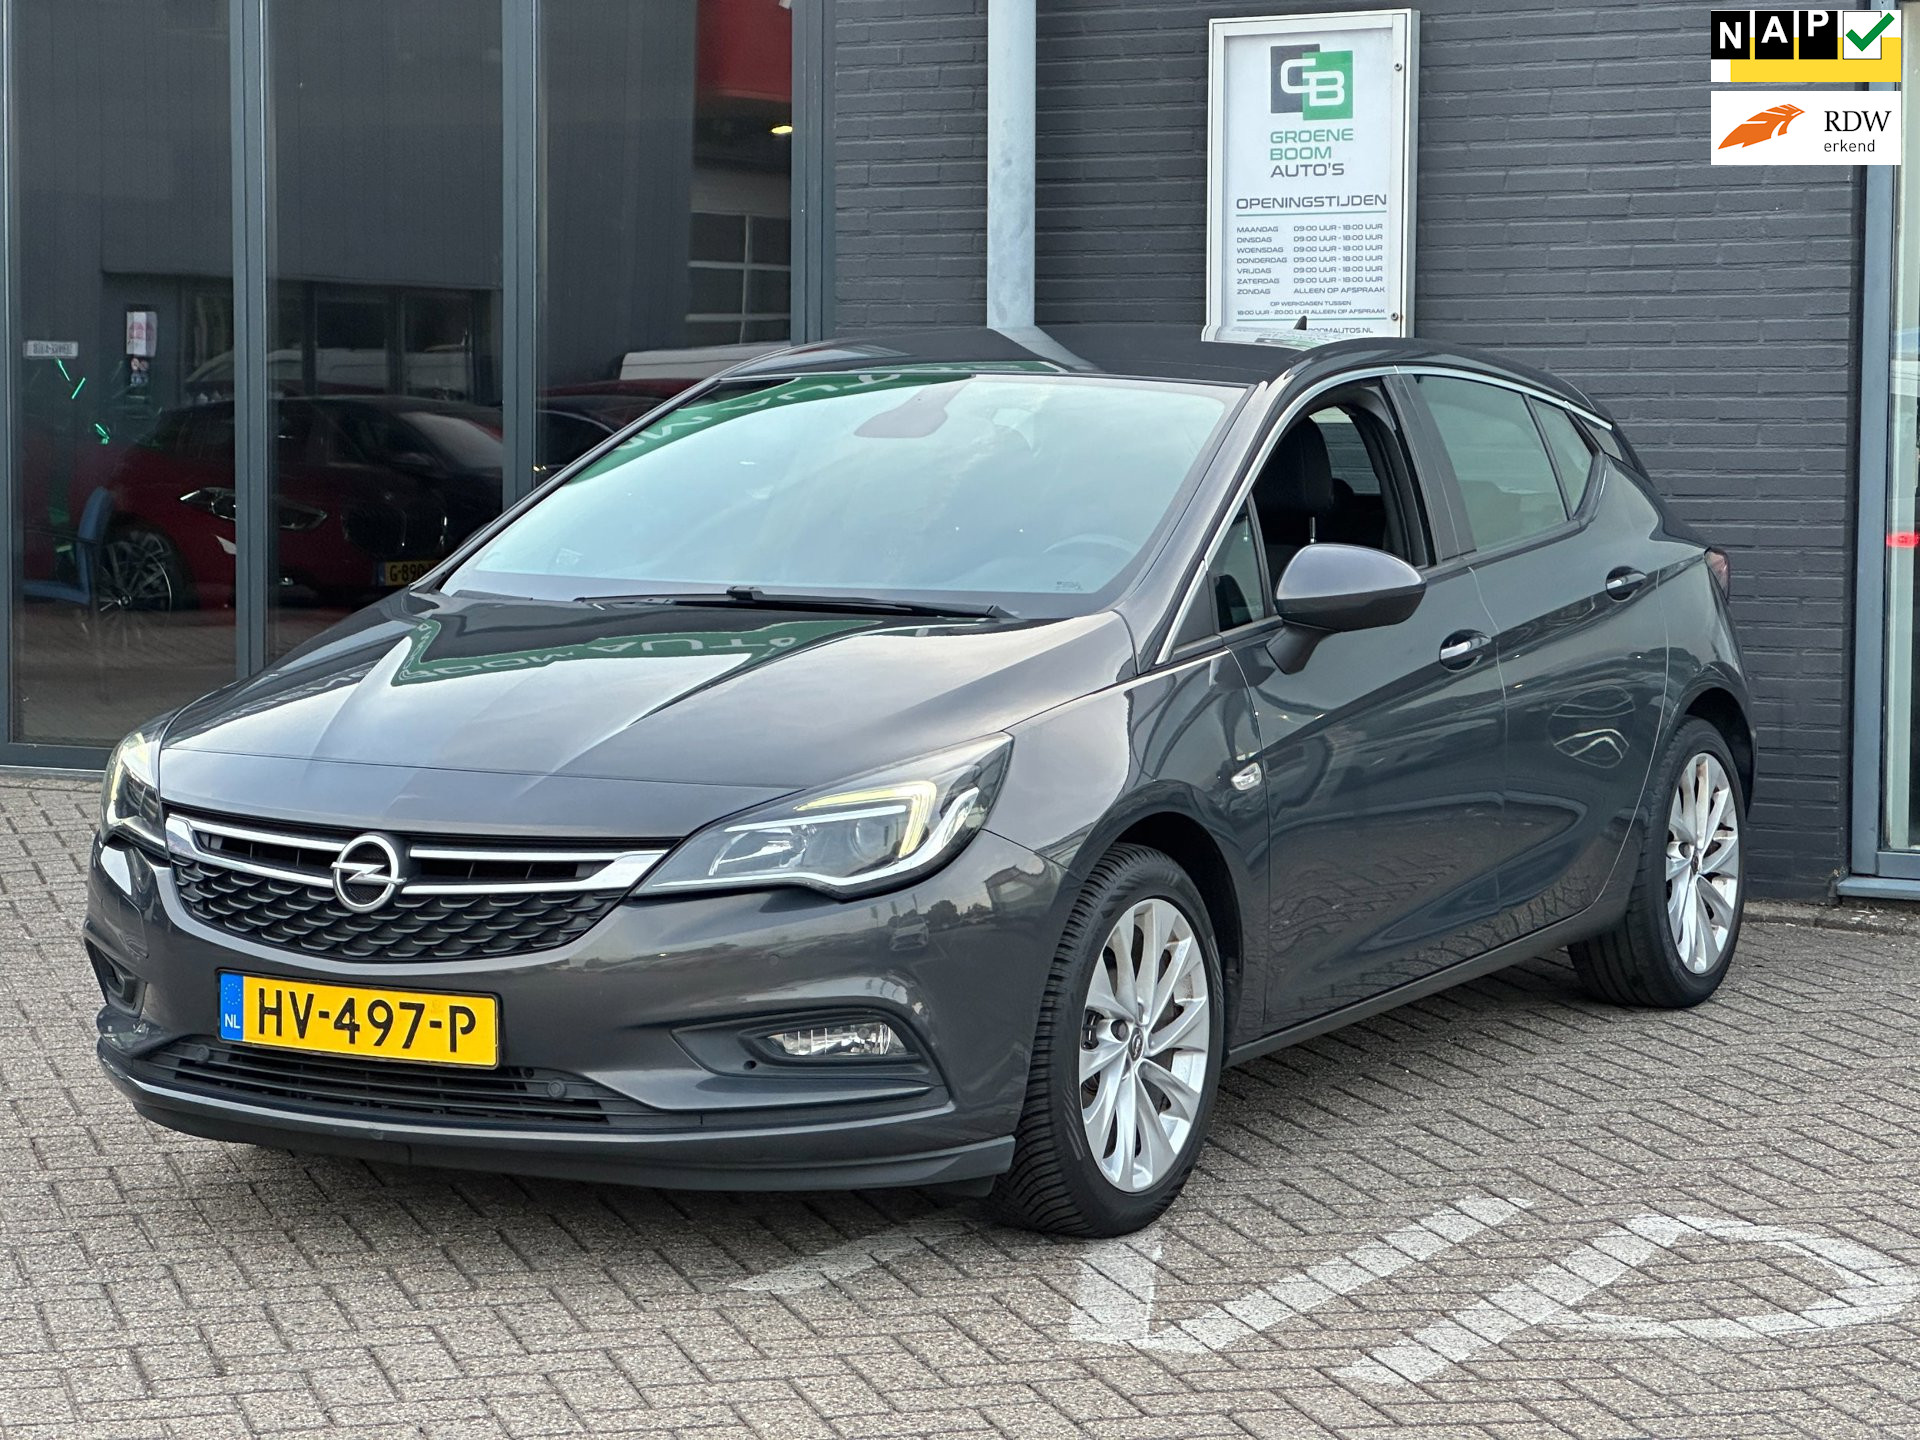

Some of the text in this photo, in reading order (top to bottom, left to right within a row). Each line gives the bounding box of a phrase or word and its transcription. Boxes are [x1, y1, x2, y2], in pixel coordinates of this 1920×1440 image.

[1270, 128, 1354, 144] GROENE
[1270, 146, 1332, 161] BOOM
[1270, 162, 1345, 178] AUTO'S
[1236, 194, 1387, 209] OPENINGSTIJDEN
[224, 1013, 240, 1029] NL
[258, 987, 476, 1053] HV-497-P
